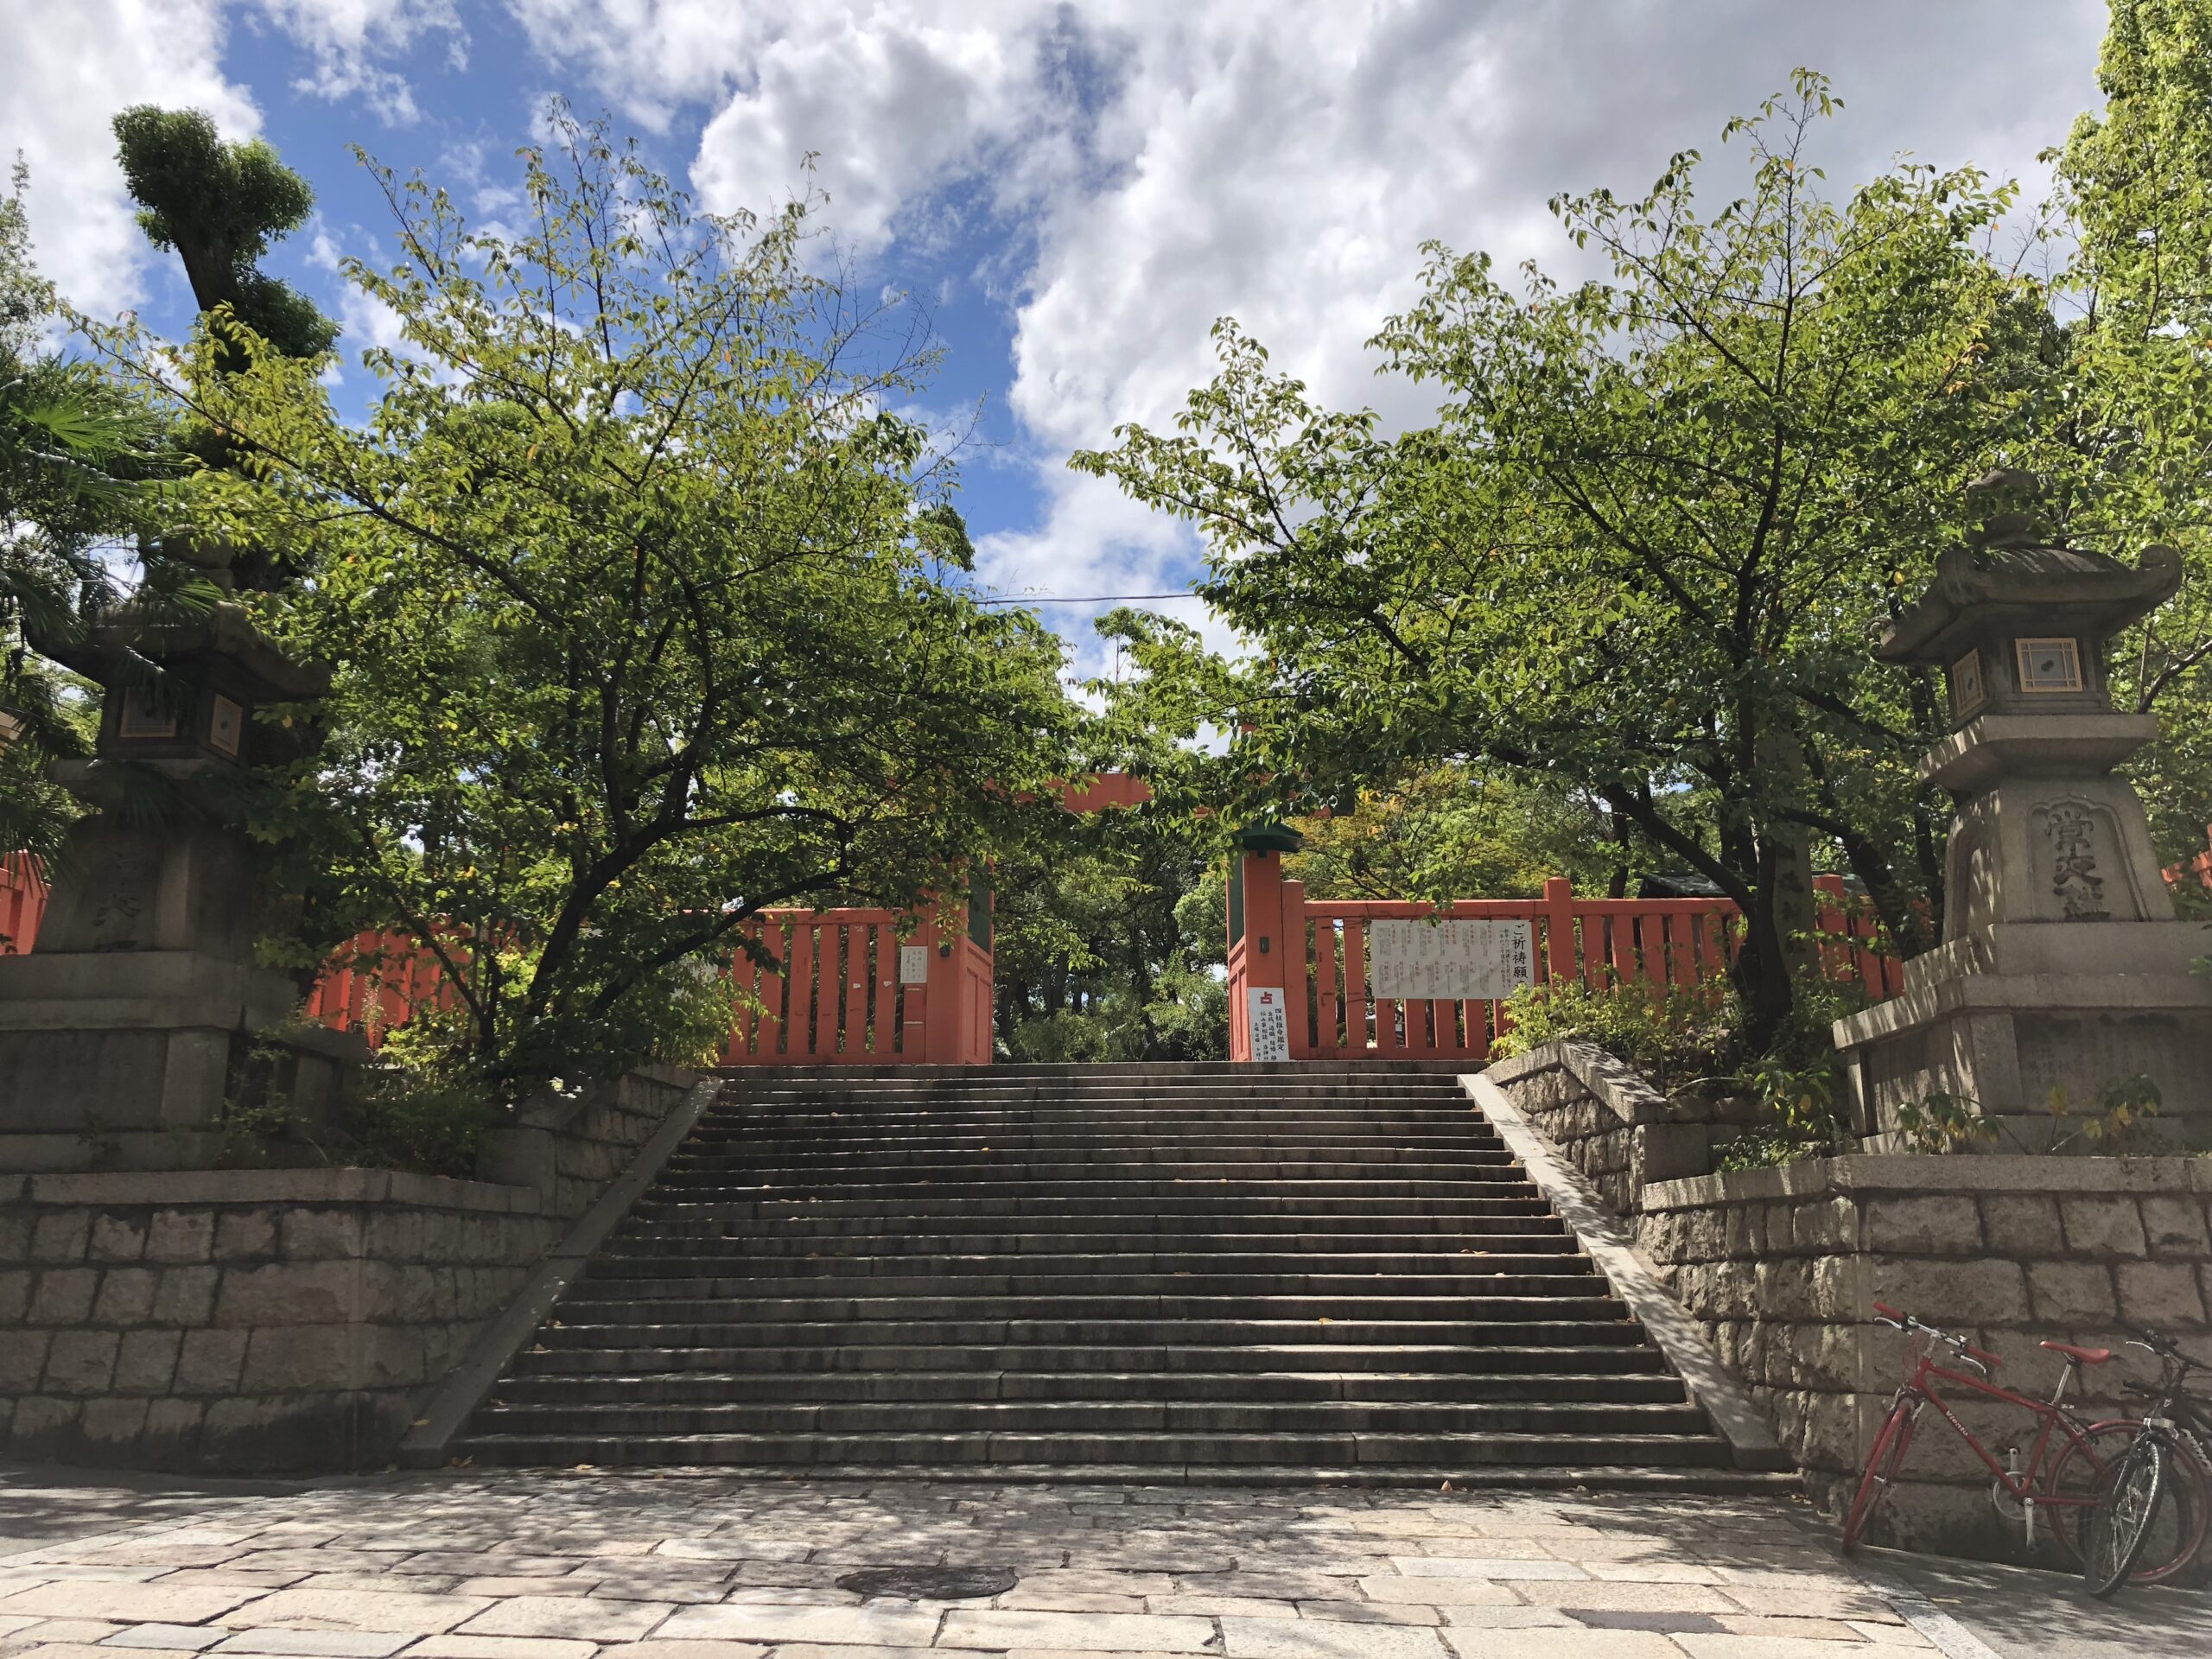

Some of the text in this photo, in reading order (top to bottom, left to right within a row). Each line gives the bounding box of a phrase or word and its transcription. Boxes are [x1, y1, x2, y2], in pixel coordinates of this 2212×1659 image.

[1260, 991, 1273, 1004] 占
[1274, 1008, 1285, 1051] 四柱推命鑑定
